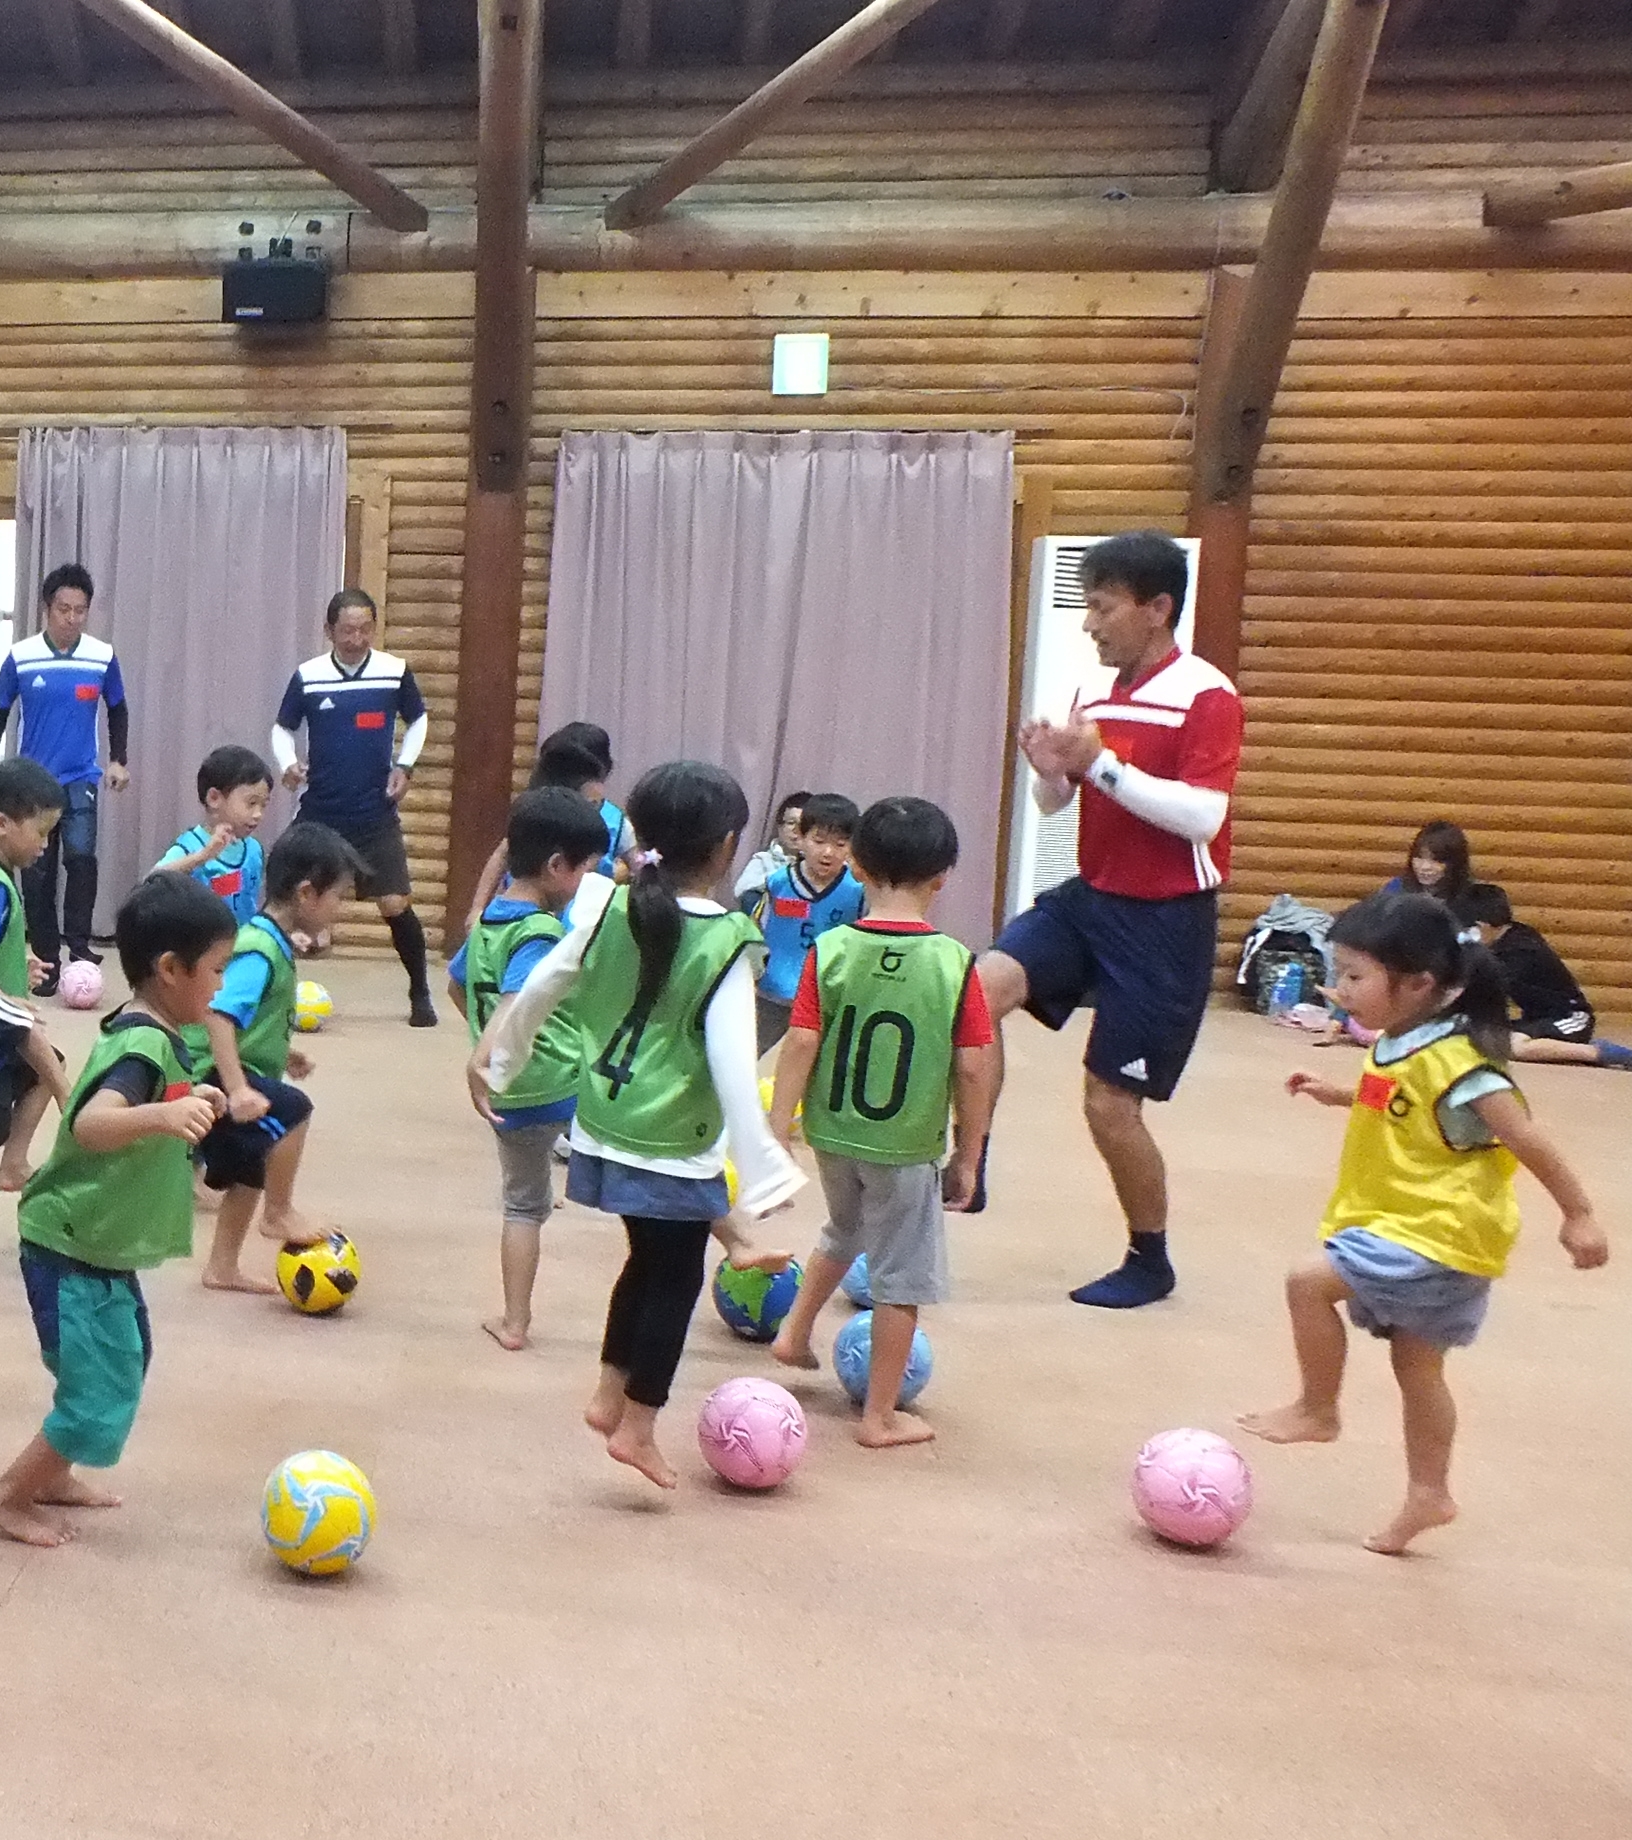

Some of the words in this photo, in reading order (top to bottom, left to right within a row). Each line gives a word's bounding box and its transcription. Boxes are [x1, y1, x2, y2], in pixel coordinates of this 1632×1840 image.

[799, 921, 817, 950] 5
[590, 1004, 647, 1101] 4
[828, 1003, 916, 1122] 10
